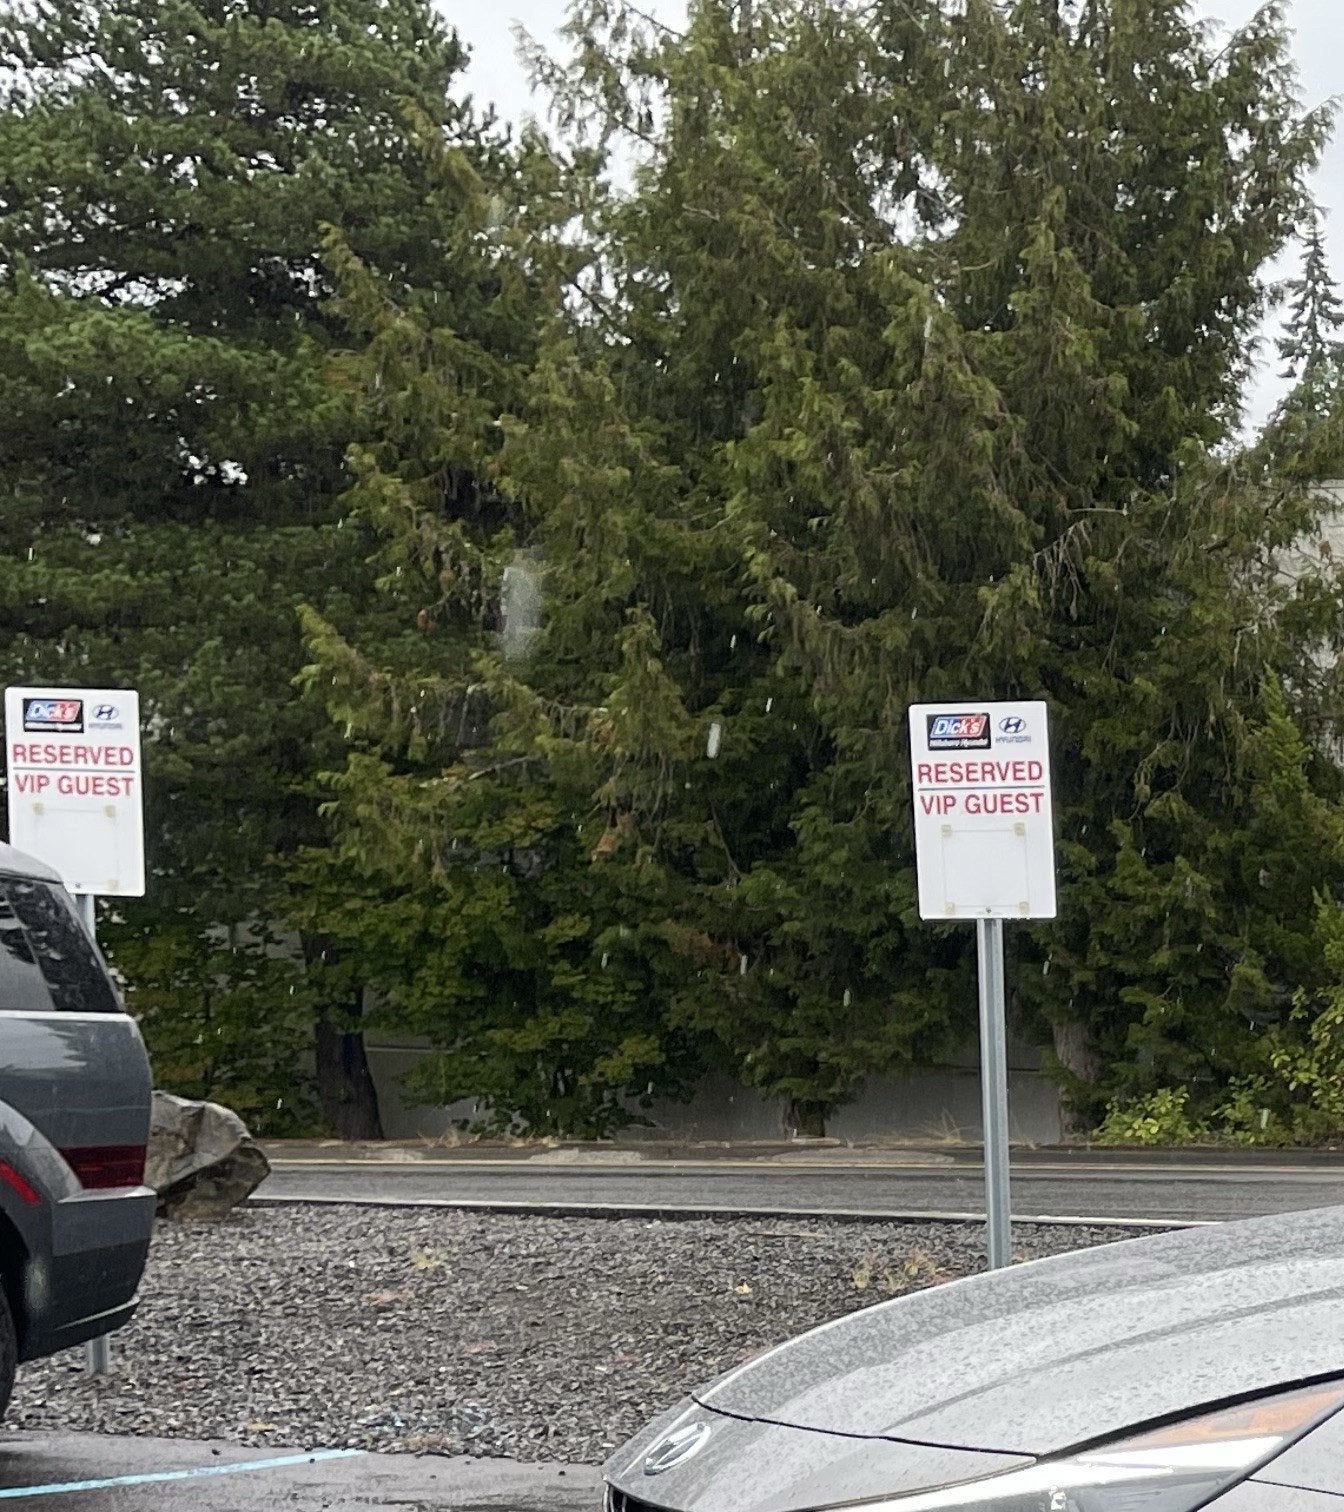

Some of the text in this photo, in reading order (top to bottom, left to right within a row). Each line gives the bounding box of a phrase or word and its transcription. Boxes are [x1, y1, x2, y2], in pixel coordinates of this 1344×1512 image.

[12, 744, 134, 765] RESERVED
[918, 761, 1043, 783] RESERVED
[15, 774, 134, 796] VIP GUEST
[921, 793, 1044, 815] VIP GUEST
